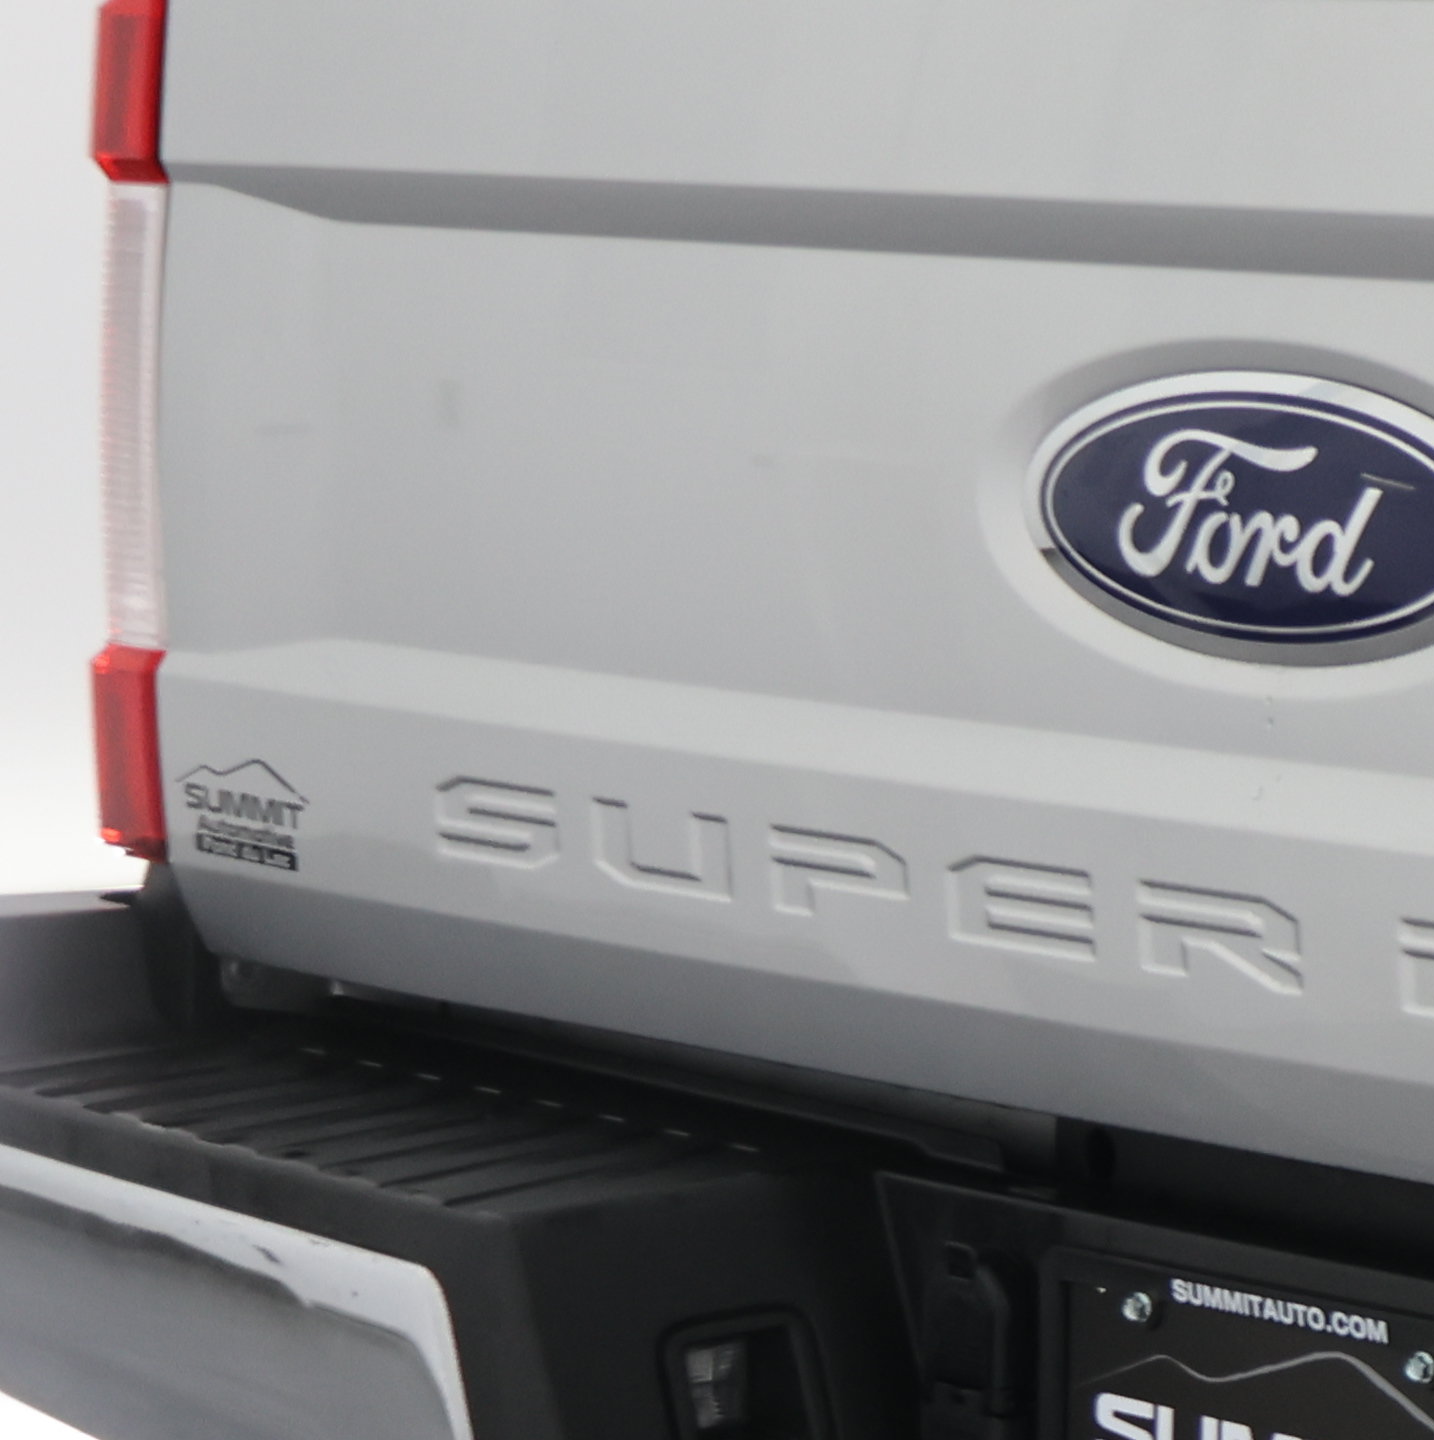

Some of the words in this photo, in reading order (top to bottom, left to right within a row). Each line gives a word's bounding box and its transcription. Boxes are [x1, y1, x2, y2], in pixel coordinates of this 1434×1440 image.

[1117, 428, 1384, 596] Ford
[183, 781, 304, 829] SUMMIT
[436, 774, 1304, 996] SUPER
[1170, 1277, 1389, 1346] SUMMITAUTO.COM
